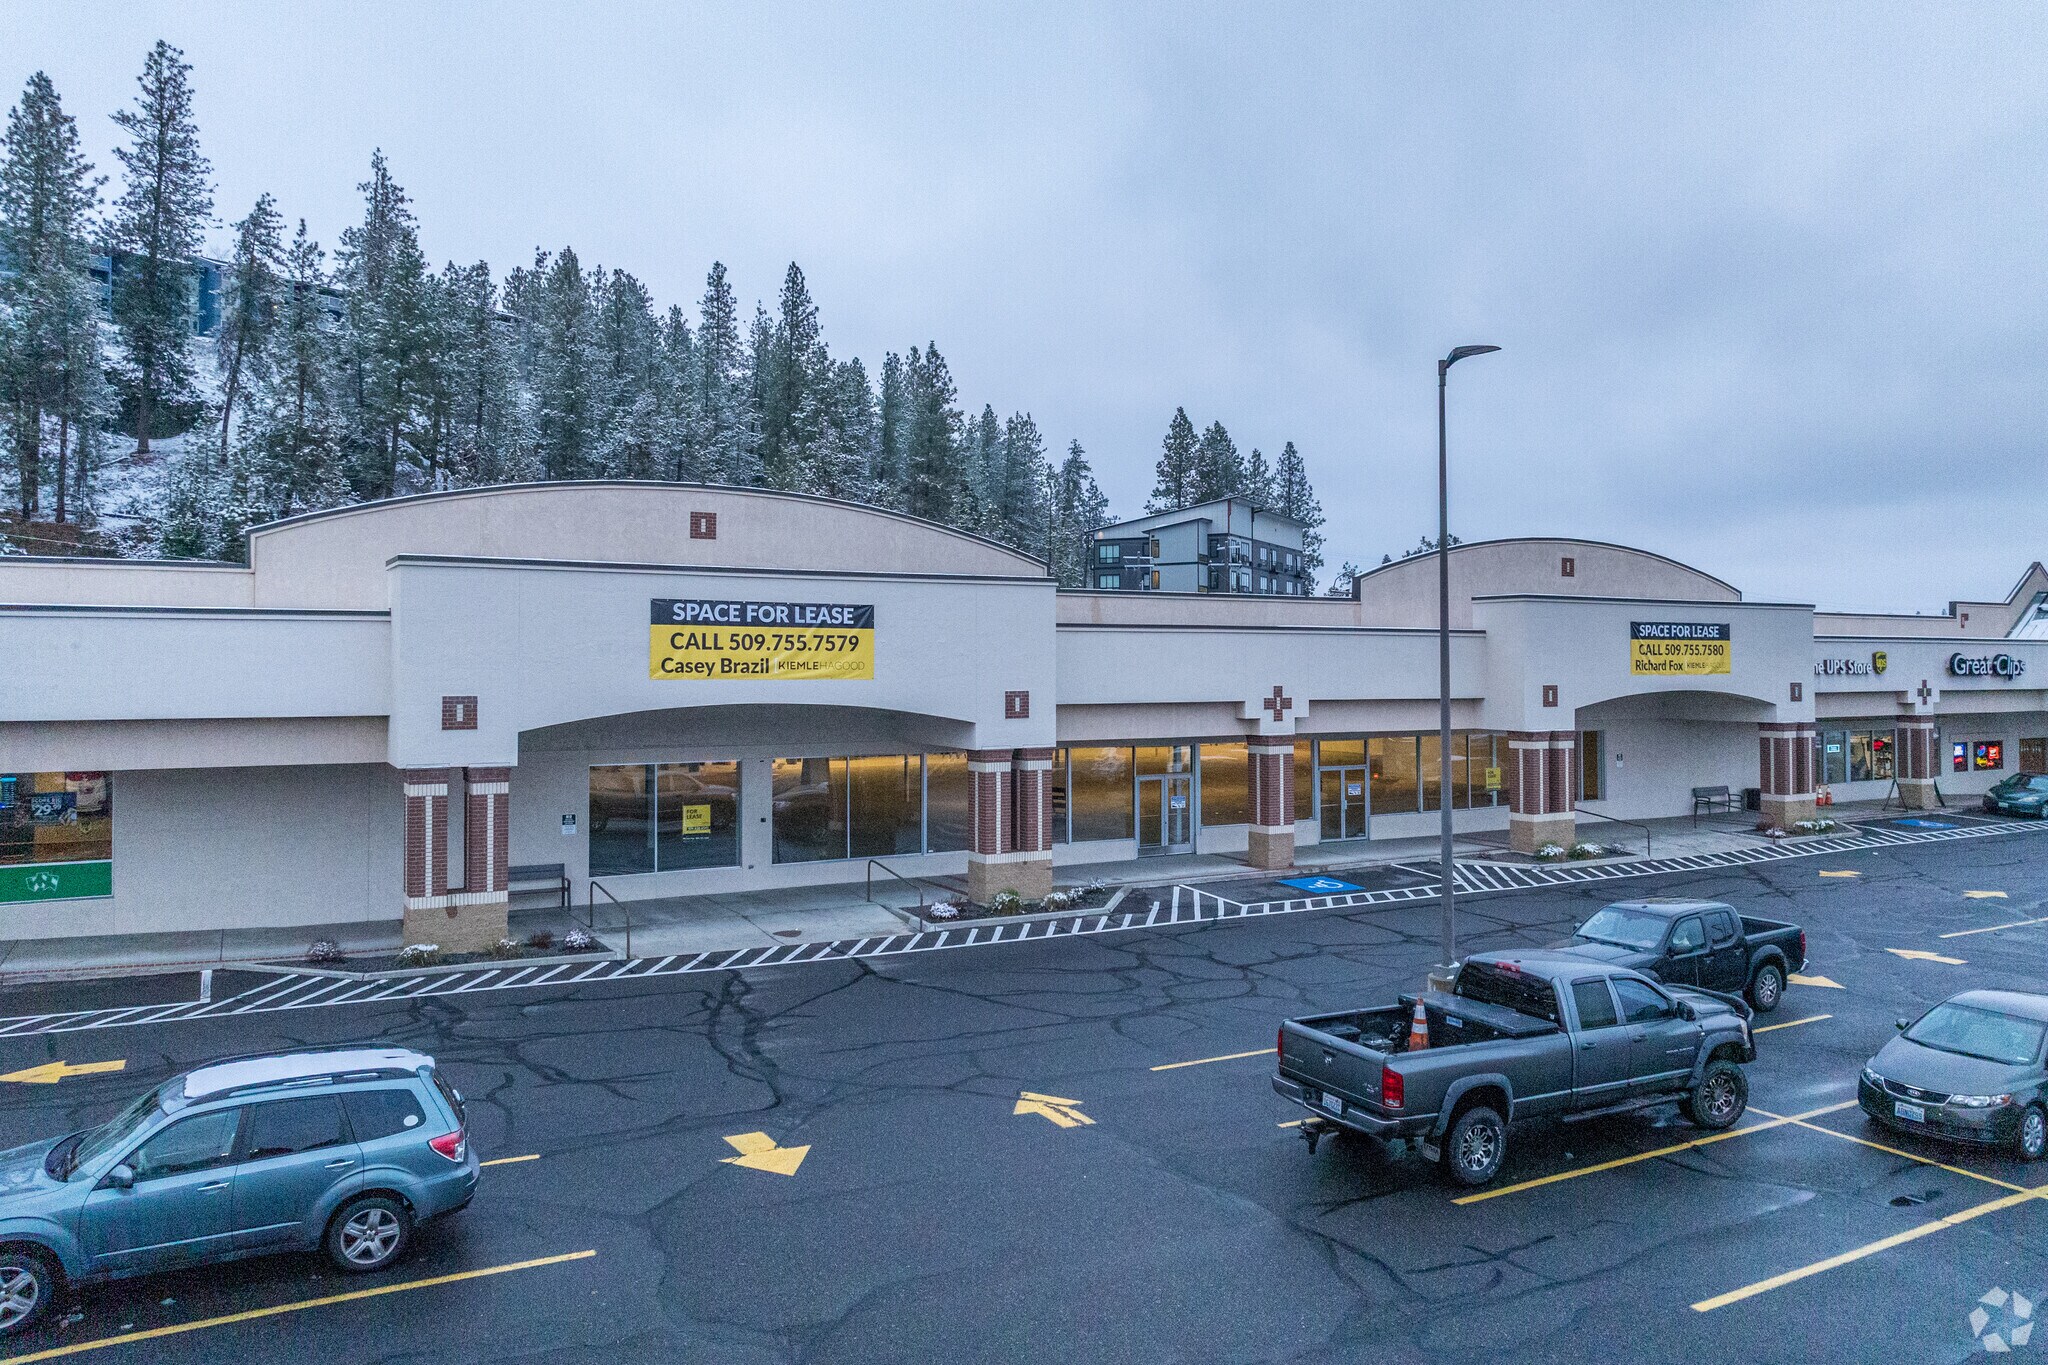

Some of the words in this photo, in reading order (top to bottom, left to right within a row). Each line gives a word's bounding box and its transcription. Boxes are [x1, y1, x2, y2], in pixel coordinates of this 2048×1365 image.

[672, 602, 741, 622] SPACE
[746, 604, 789, 624] FOR
[794, 606, 854, 625] LEASE
[1639, 624, 1670, 637] SPACE
[1671, 625, 1691, 638] FOR
[1692, 625, 1719, 638] LEASE
[670, 632, 724, 651] CALL
[729, 633, 859, 652] 509.755.7579
[1639, 643, 1663, 656] CALL
[1665, 644, 1724, 656] 509.755.7580
[660, 657, 716, 677] Casey
[720, 657, 770, 674] Brazil
[1635, 659, 1667, 671] Richard
[1669, 660, 1684, 671] Fox
[1826, 659, 1846, 674] UPS
[1848, 659, 1872, 674] Store
[1954, 654, 1993, 675] Great
[1996, 655, 2026, 681] Clips
